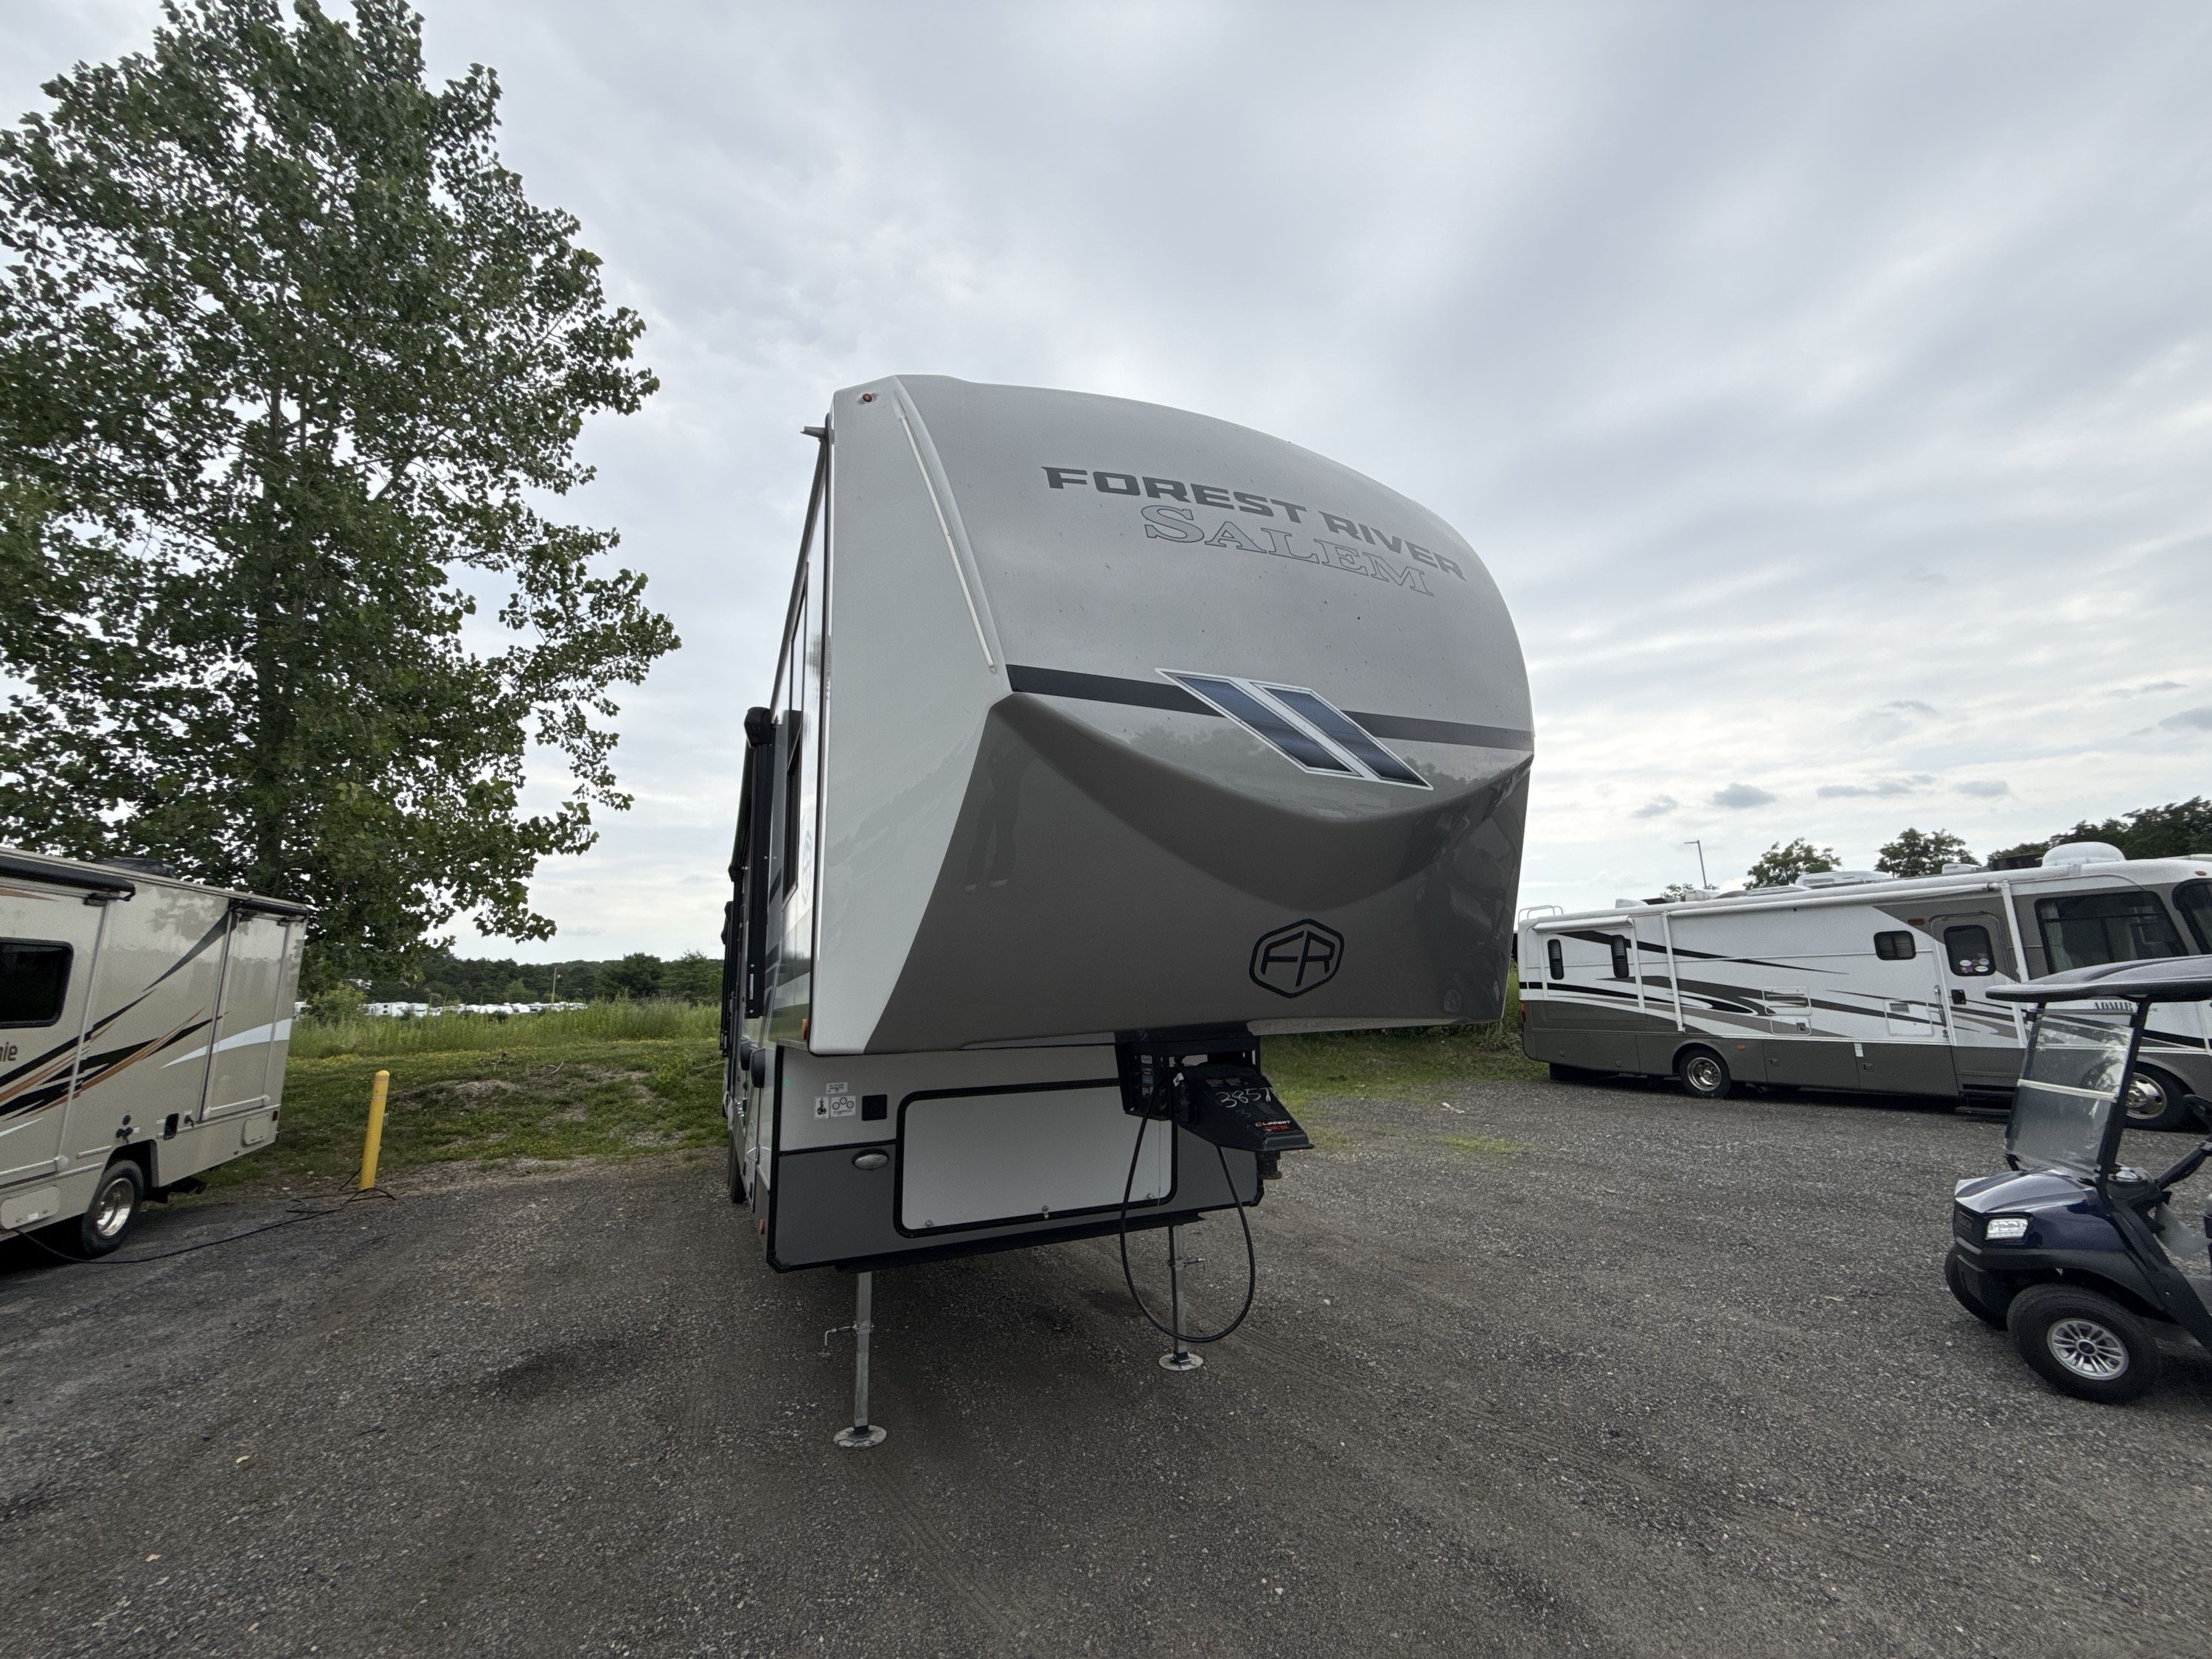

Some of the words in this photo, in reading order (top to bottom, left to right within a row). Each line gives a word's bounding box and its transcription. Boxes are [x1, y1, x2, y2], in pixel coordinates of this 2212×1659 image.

[1040, 466, 1307, 524] FOREST
[1318, 510, 1467, 582] RIVER
[1141, 504, 1434, 596] SALEM
[1216, 1087, 1271, 1107] 3857
